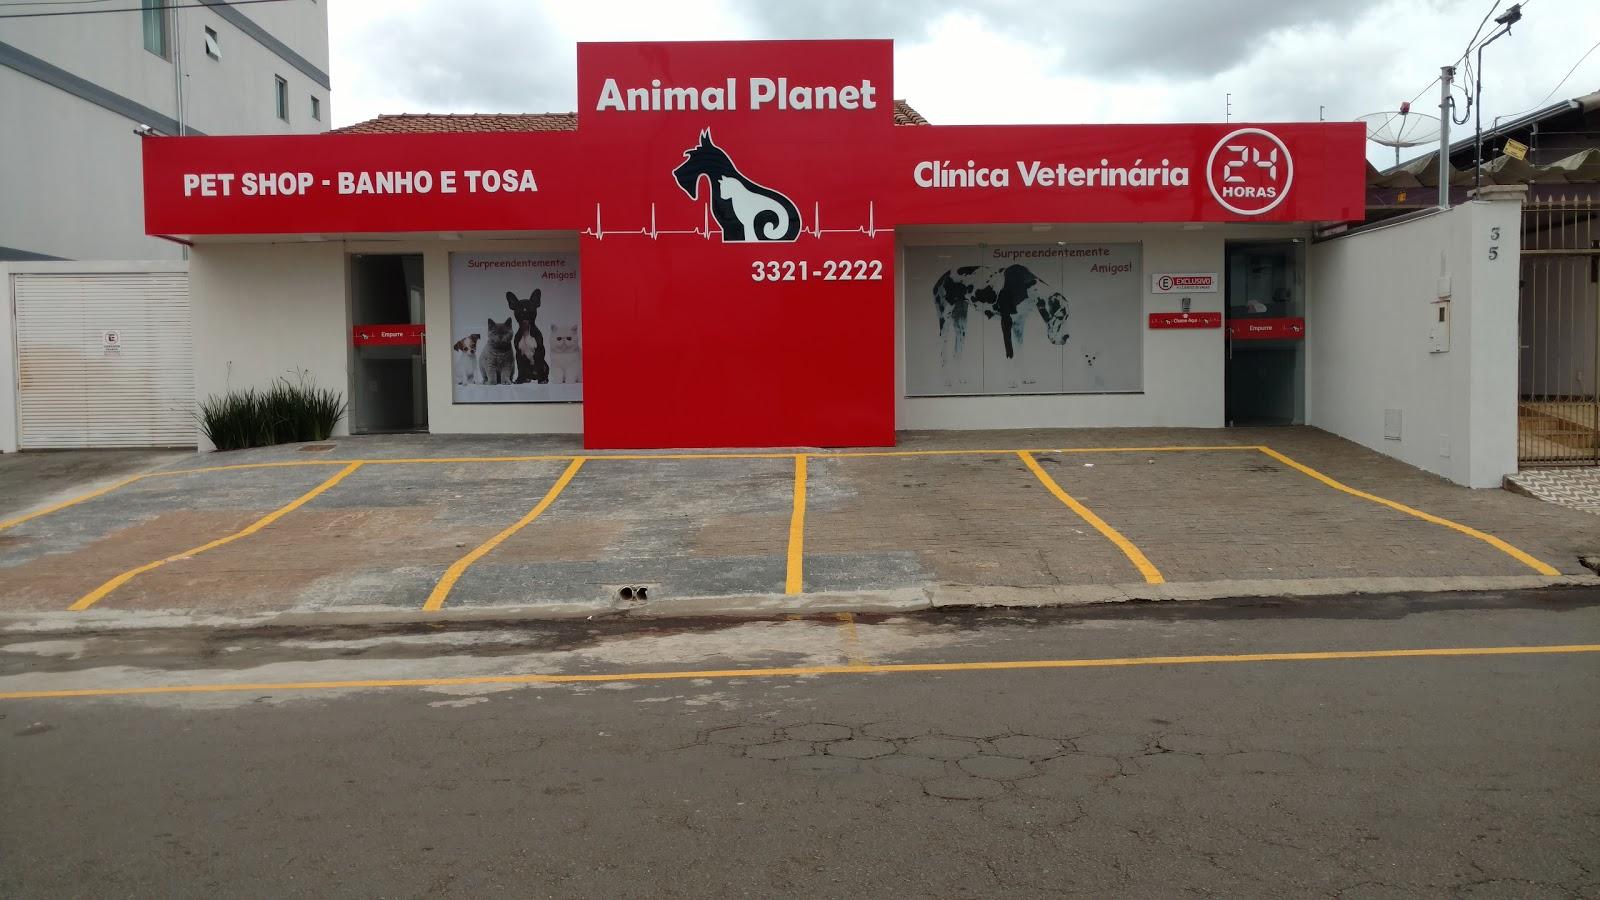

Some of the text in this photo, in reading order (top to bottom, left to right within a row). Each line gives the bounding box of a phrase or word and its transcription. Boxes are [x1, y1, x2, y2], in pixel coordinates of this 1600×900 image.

[596, 77, 877, 111] Animal Planet
[1223, 145, 1278, 183] 24
[913, 158, 1189, 188] Clínica Veterinária
[183, 169, 538, 197] PET SHOP - BANHO E TOSA
[1222, 186, 1277, 198] HORAS
[993, 248, 1110, 260] Surpreendentemente
[468, 258, 567, 269] Surpreendentemente
[751, 259, 883, 281] 3321-2222
[1090, 261, 1133, 275] Amigos!
[541, 270, 577, 281] Amigos!
[1162, 278, 1169, 288] E
